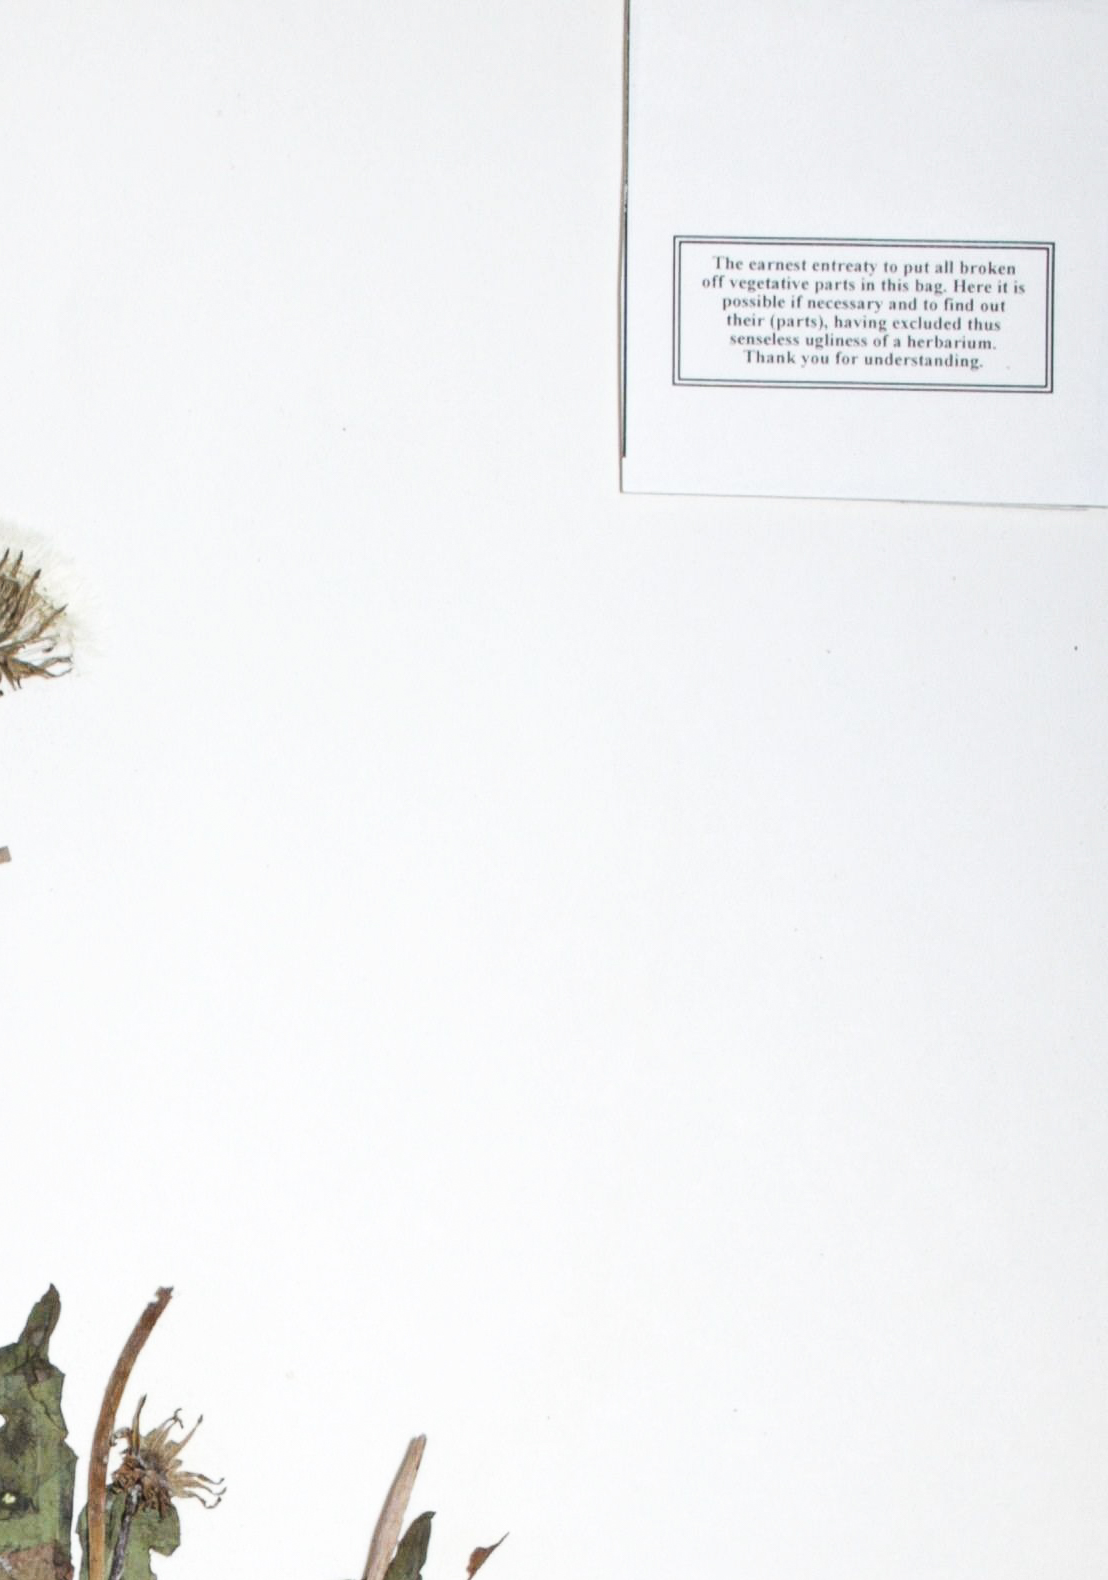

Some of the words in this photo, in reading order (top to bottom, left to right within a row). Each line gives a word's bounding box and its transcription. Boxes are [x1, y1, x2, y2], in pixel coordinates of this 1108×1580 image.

[712, 255, 744, 270] The
[749, 260, 807, 271] earnest
[812, 260, 877, 276] entreaty
[884, 261, 898, 273] to
[904, 262, 929, 276] put
[935, 261, 953, 274] all
[960, 261, 1016, 275] broken
[702, 275, 724, 288] off
[730, 277, 809, 291] vegetative
[815, 279, 855, 293] parts
[861, 278, 875, 291] in
[881, 279, 909, 291] this
[915, 280, 947, 294] bag.
[953, 279, 992, 293] Here
[997, 281, 1007, 293] it
[1014, 281, 1025, 293] is
[722, 295, 785, 310] possible
[791, 296, 803, 308] if
[807, 300, 882, 313] necessary
[889, 298, 917, 311] and
[924, 300, 938, 311] to
[944, 298, 974, 312] find
[980, 301, 1005, 312] out
[727, 313, 764, 326] their
[770, 314, 828, 330] (parts),
[834, 315, 887, 330] having
[892, 317, 961, 331] excluded
[968, 318, 1001, 331] thus
[730, 333, 799, 345] senseless
[805, 334, 868, 348] ugliness
[873, 334, 888, 348] of
[893, 338, 901, 348] a
[907, 335, 996, 350] herbarium.
[743, 350, 795, 364] Thank
[801, 354, 829, 368] you
[835, 352, 858, 365] for
[864, 353, 983, 370] understanding.
